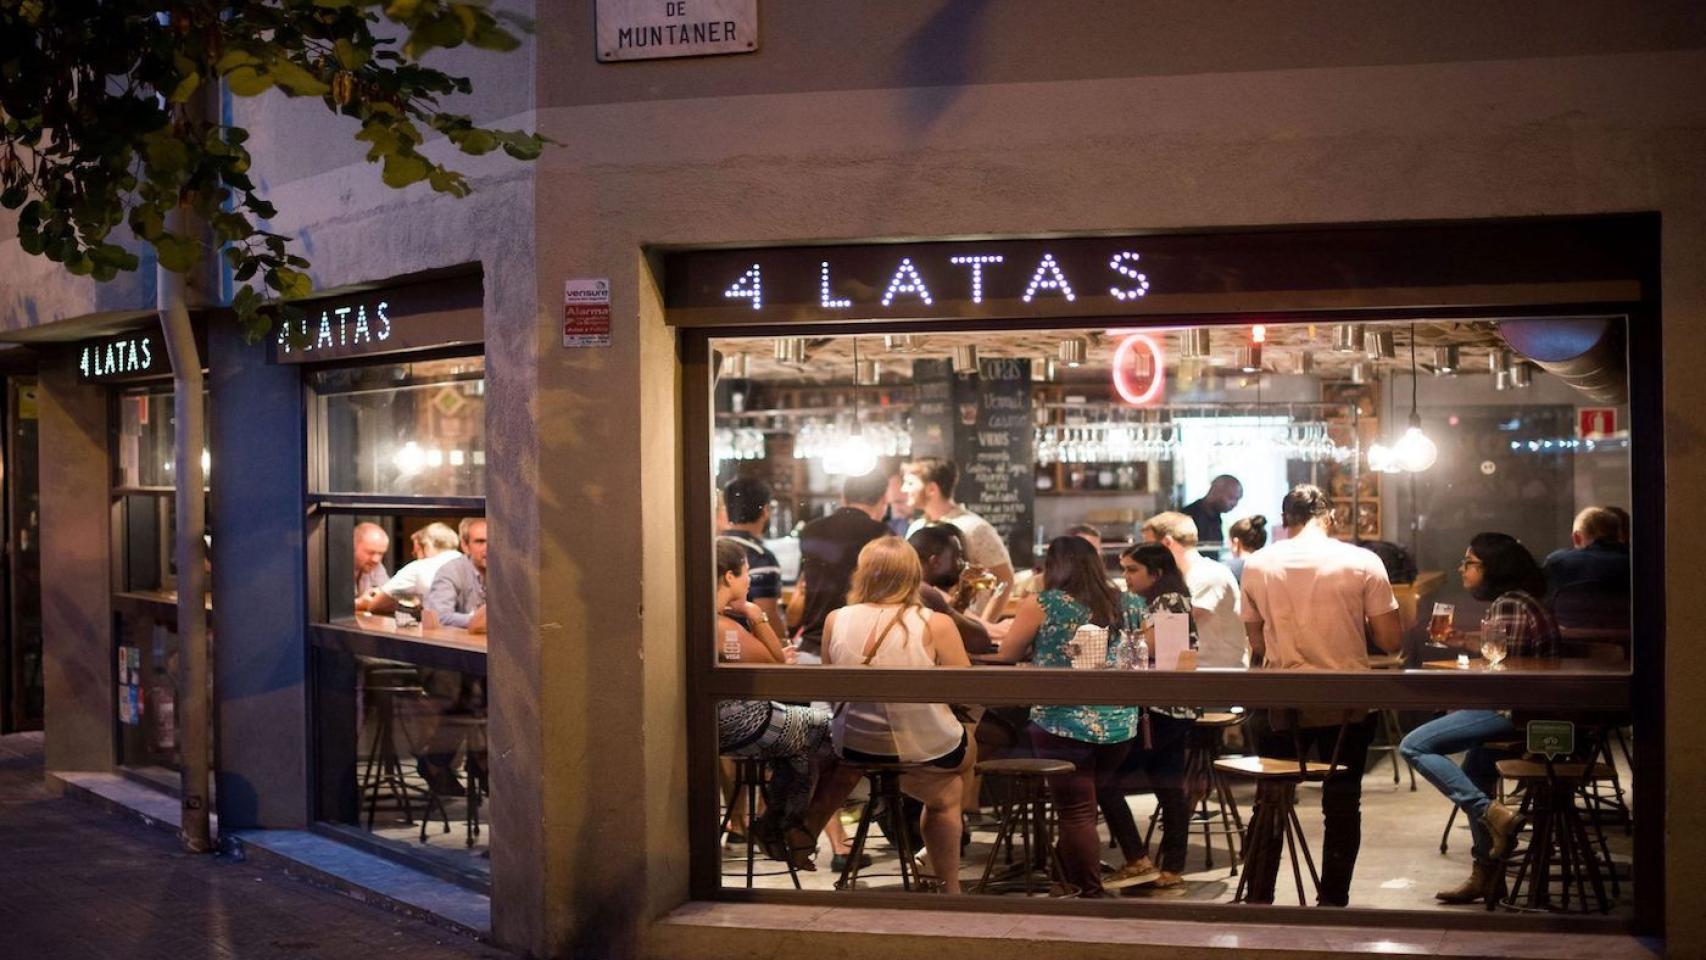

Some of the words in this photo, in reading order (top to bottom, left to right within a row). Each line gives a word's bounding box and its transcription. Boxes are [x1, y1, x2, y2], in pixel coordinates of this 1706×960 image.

[666, 2, 686, 16] DE
[618, 21, 737, 48] MUNTANER
[725, 263, 762, 310] 4
[820, 252, 1150, 309] LATAS
[79, 347, 90, 377] 4
[94, 337, 151, 375] LATAS
